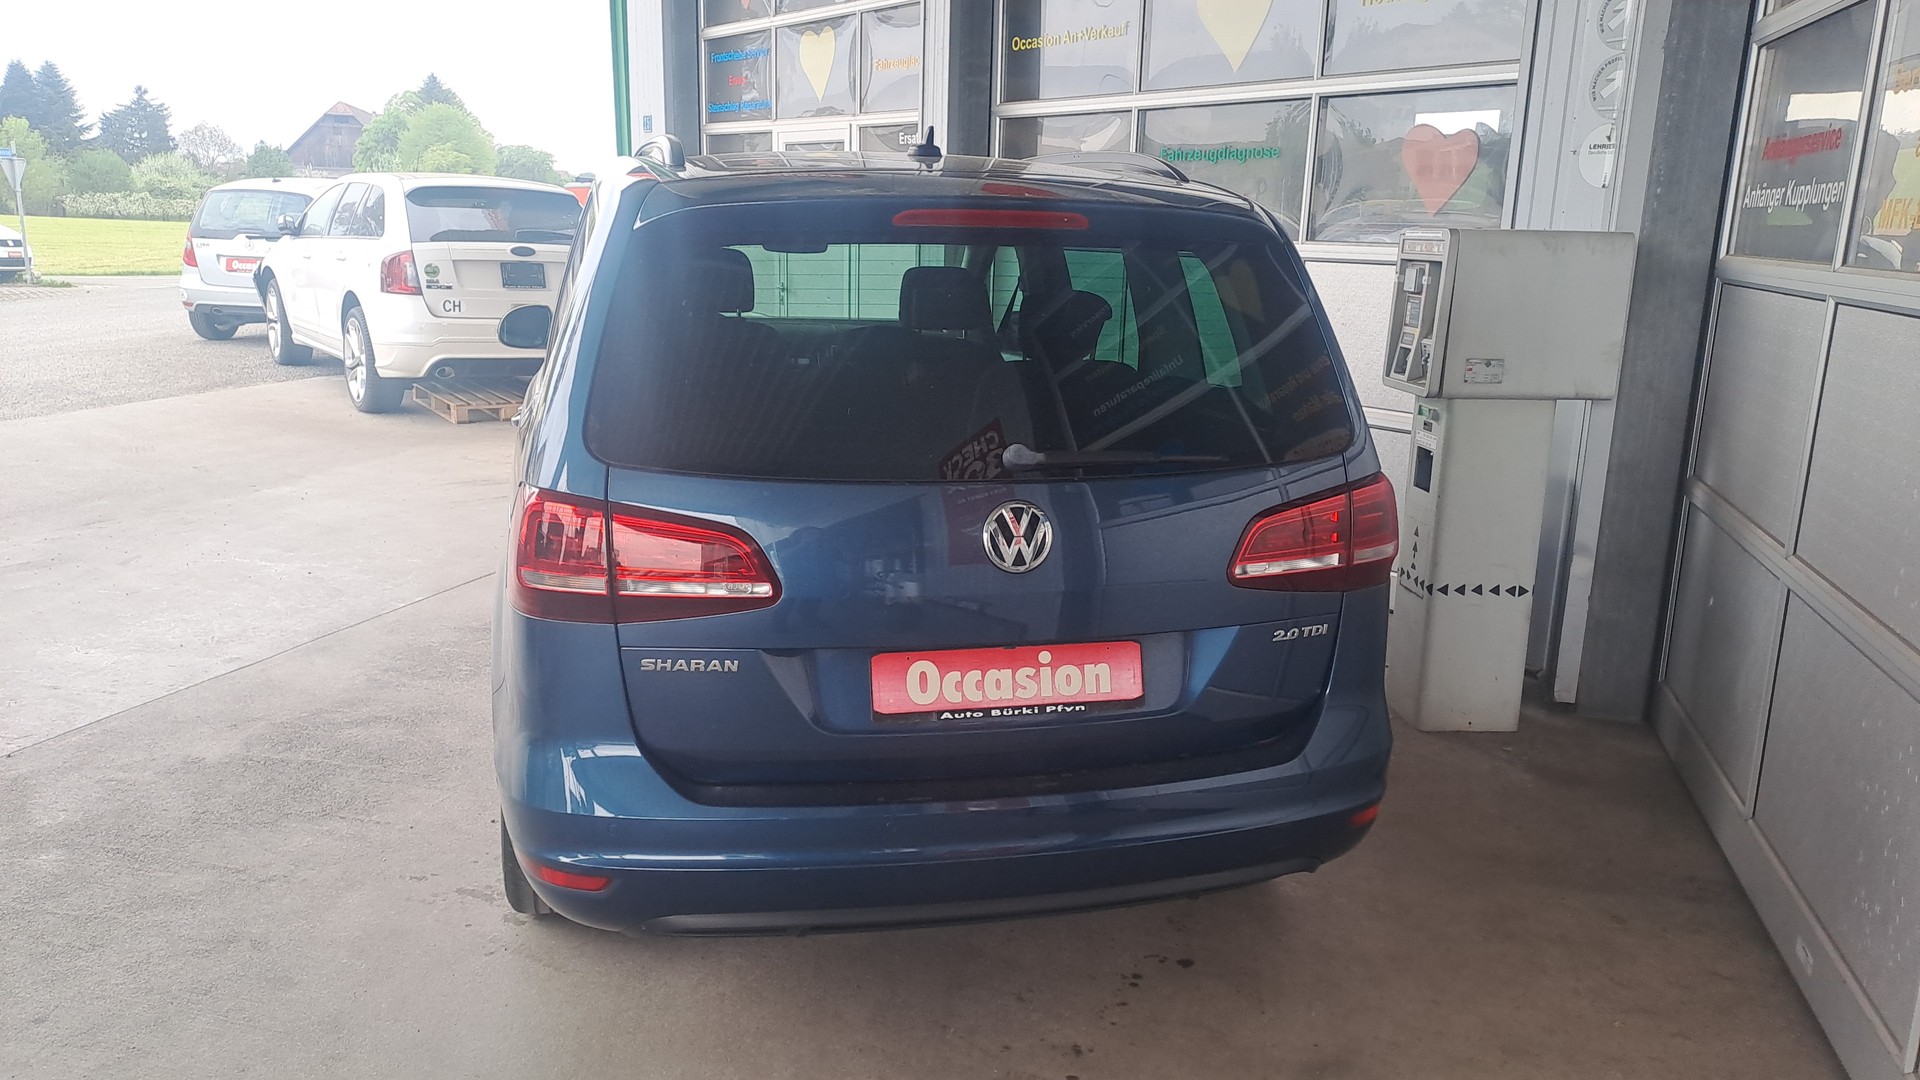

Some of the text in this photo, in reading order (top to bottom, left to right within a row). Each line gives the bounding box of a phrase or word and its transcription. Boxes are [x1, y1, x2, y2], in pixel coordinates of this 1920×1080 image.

[1012, 33, 1061, 51] Occasion
[1160, 143, 1280, 165] Fahrzeugdiagnose
[1742, 177, 1846, 213] Anhänger Kupplungen
[442, 299, 462, 313] CH
[1301, 623, 1329, 638] TDI
[640, 658, 739, 673] SHARAN
[905, 650, 1112, 705] Occasion
[940, 704, 1086, 720] Auto Bürki Pfyn
